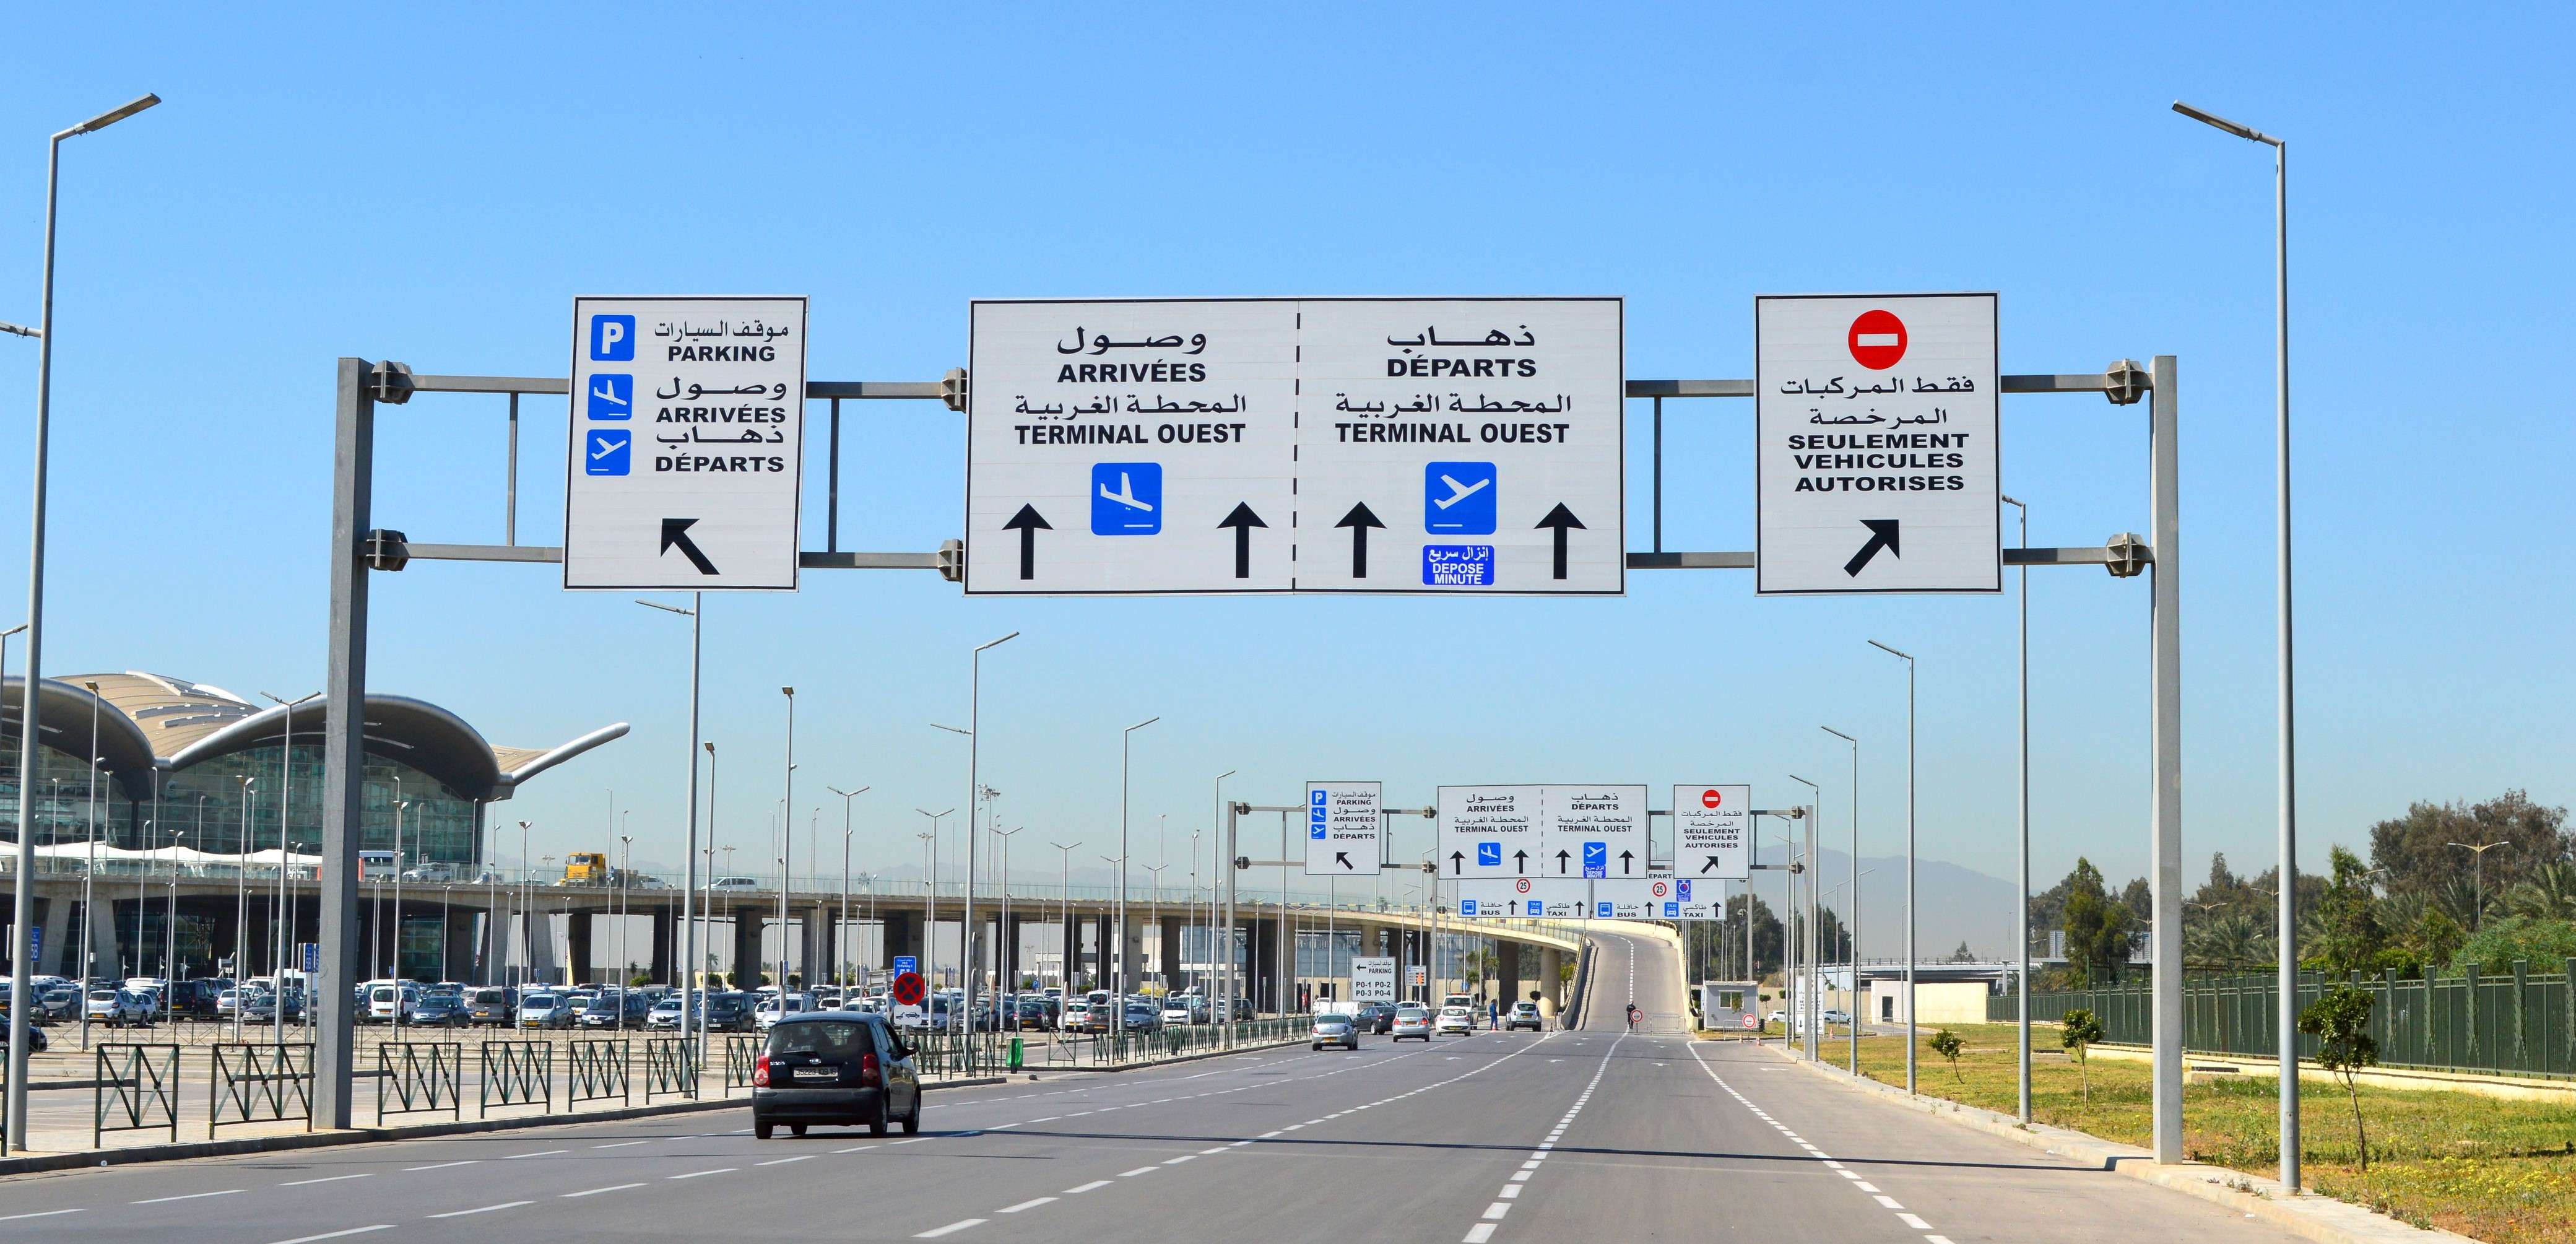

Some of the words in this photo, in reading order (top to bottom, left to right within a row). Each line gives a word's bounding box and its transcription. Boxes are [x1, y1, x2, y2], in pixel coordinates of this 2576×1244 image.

[602, 323, 623, 354] P
[655, 320, 727, 342] السيارات
[733, 320, 788, 342] موقف
[1057, 326, 1206, 355] وصول
[1387, 325, 1535, 354] ذهاب
[669, 346, 774, 362] PARKING
[1057, 359, 1206, 383] ARRIVÉES
[1388, 354, 1536, 377] DÉPARTS
[657, 376, 786, 401] وصول
[1781, 376, 1904, 399] المركبات
[1912, 376, 1974, 393] فقط
[1015, 395, 1117, 420] الغربية
[1127, 394, 1246, 414] المحطة
[1336, 393, 1439, 419] الغربية
[1449, 393, 1571, 414] المحطة
[656, 404, 786, 423] ARRIVÉES
[1810, 407, 1946, 429] المرخصة
[657, 425, 783, 450] ذهاب
[1015, 425, 1148, 444] TERMINAL
[1158, 424, 1246, 443] OUEST
[1335, 424, 1471, 443] TERMINAL
[1481, 424, 1569, 443] OUEST
[1789, 433, 1969, 450] SEULEMENT
[656, 453, 784, 472] DÉPARTS
[1793, 453, 1963, 469] VEHICULES
[1795, 476, 1964, 492] AUTORISES
[1429, 550, 1458, 562] سريع
[1433, 563, 1483, 573] DEPOSE
[1435, 574, 1481, 584] MINUTE
[1316, 793, 1322, 803] P
[1467, 794, 1514, 803] وصول
[1571, 793, 1618, 803] ذهاب
[1334, 807, 1376, 815] وصول
[1558, 816, 1590, 824] الغربية
[1334, 824, 1374, 832] ذهاب
[1455, 817, 1488, 825] الغربية
